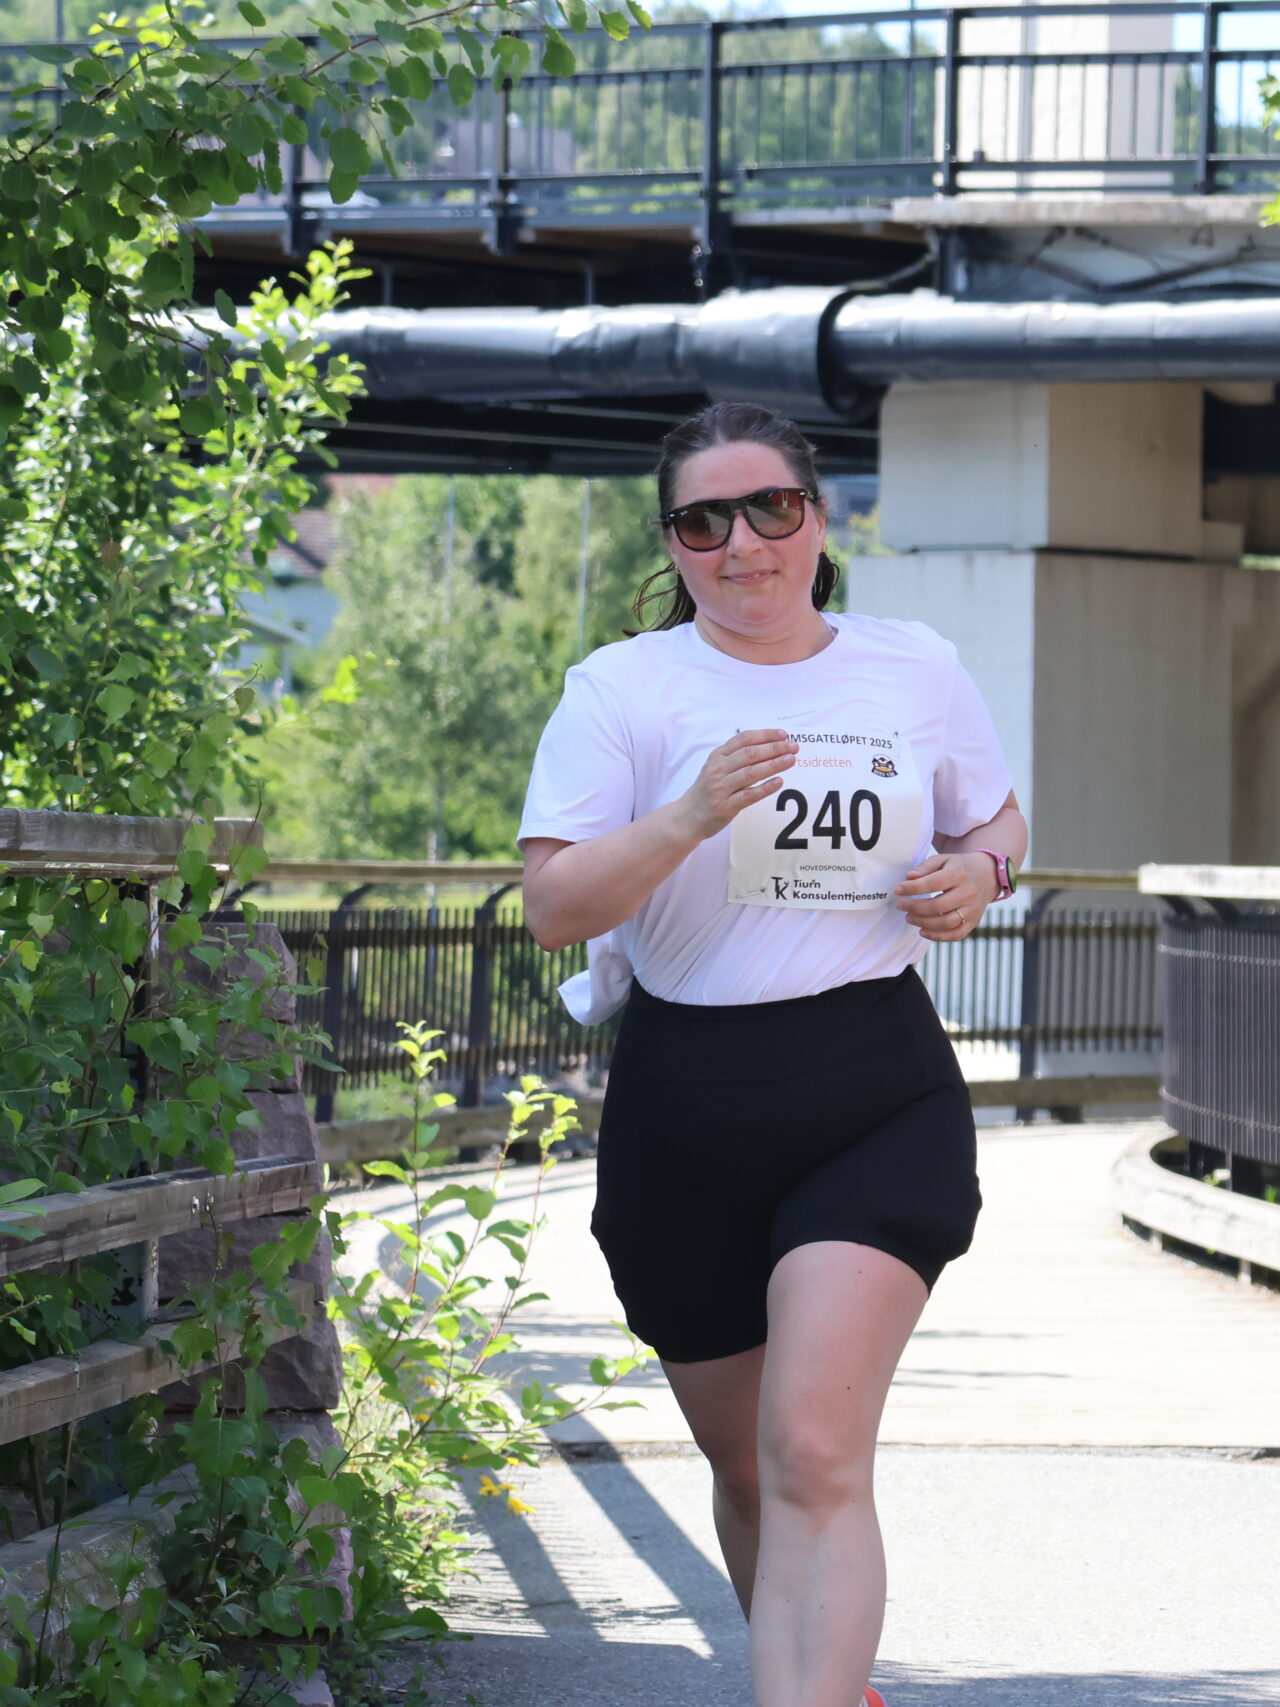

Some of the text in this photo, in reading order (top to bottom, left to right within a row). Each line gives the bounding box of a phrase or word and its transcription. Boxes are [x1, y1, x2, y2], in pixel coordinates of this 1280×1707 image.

[786, 733, 893, 749] MSGATELØPET 2025
[796, 756, 852, 768] tsidretten
[774, 788, 882, 851] 240
[793, 890, 888, 903] Konsulenttjenester
